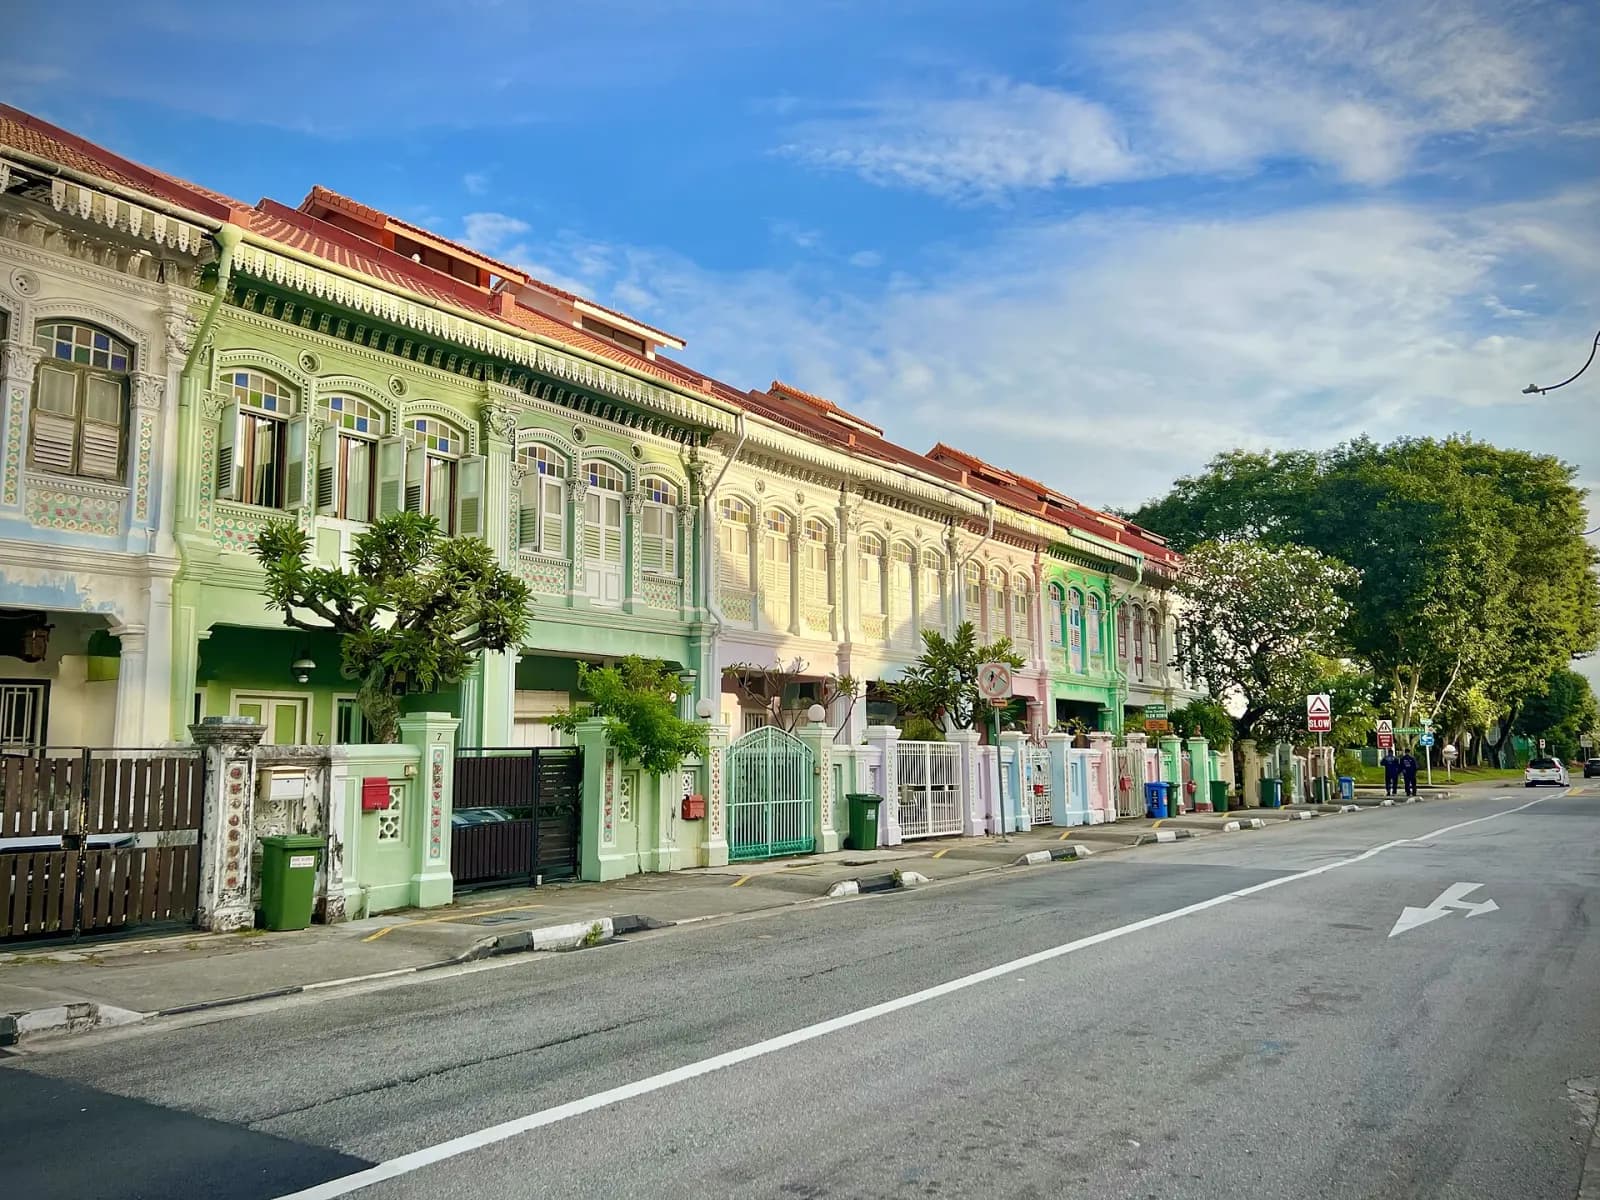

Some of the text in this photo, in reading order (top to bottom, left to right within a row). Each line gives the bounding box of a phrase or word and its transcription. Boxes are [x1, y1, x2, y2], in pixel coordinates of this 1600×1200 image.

[1309, 719, 1331, 728] SLOW
[317, 732, 324, 744] 7
[436, 733, 442, 741] 7
